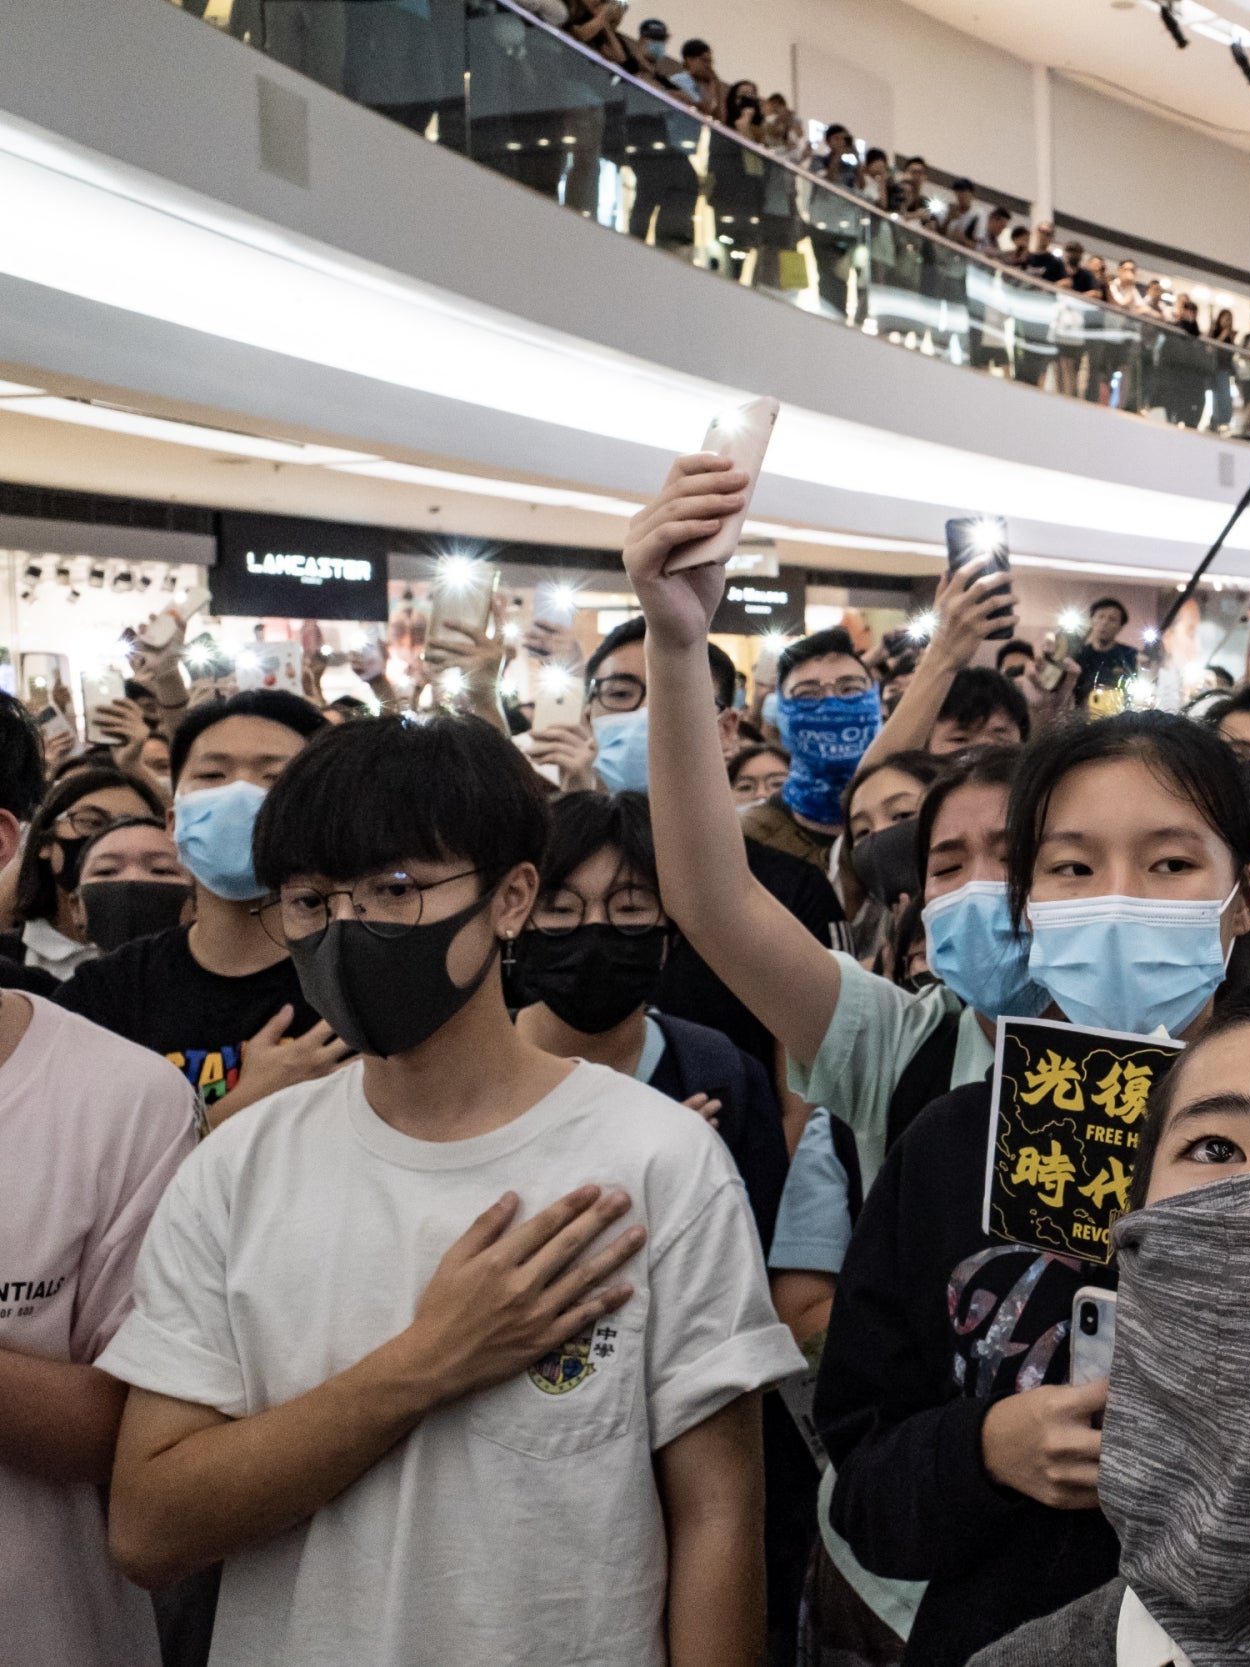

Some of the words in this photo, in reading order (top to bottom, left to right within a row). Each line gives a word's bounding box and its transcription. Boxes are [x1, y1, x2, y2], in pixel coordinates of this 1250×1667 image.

[246, 552, 371, 581] LANCASTER
[1020, 1049, 1154, 1124] 光復
[1085, 1124, 1124, 1146] FREE
[1011, 1139, 1136, 1213] 時代
